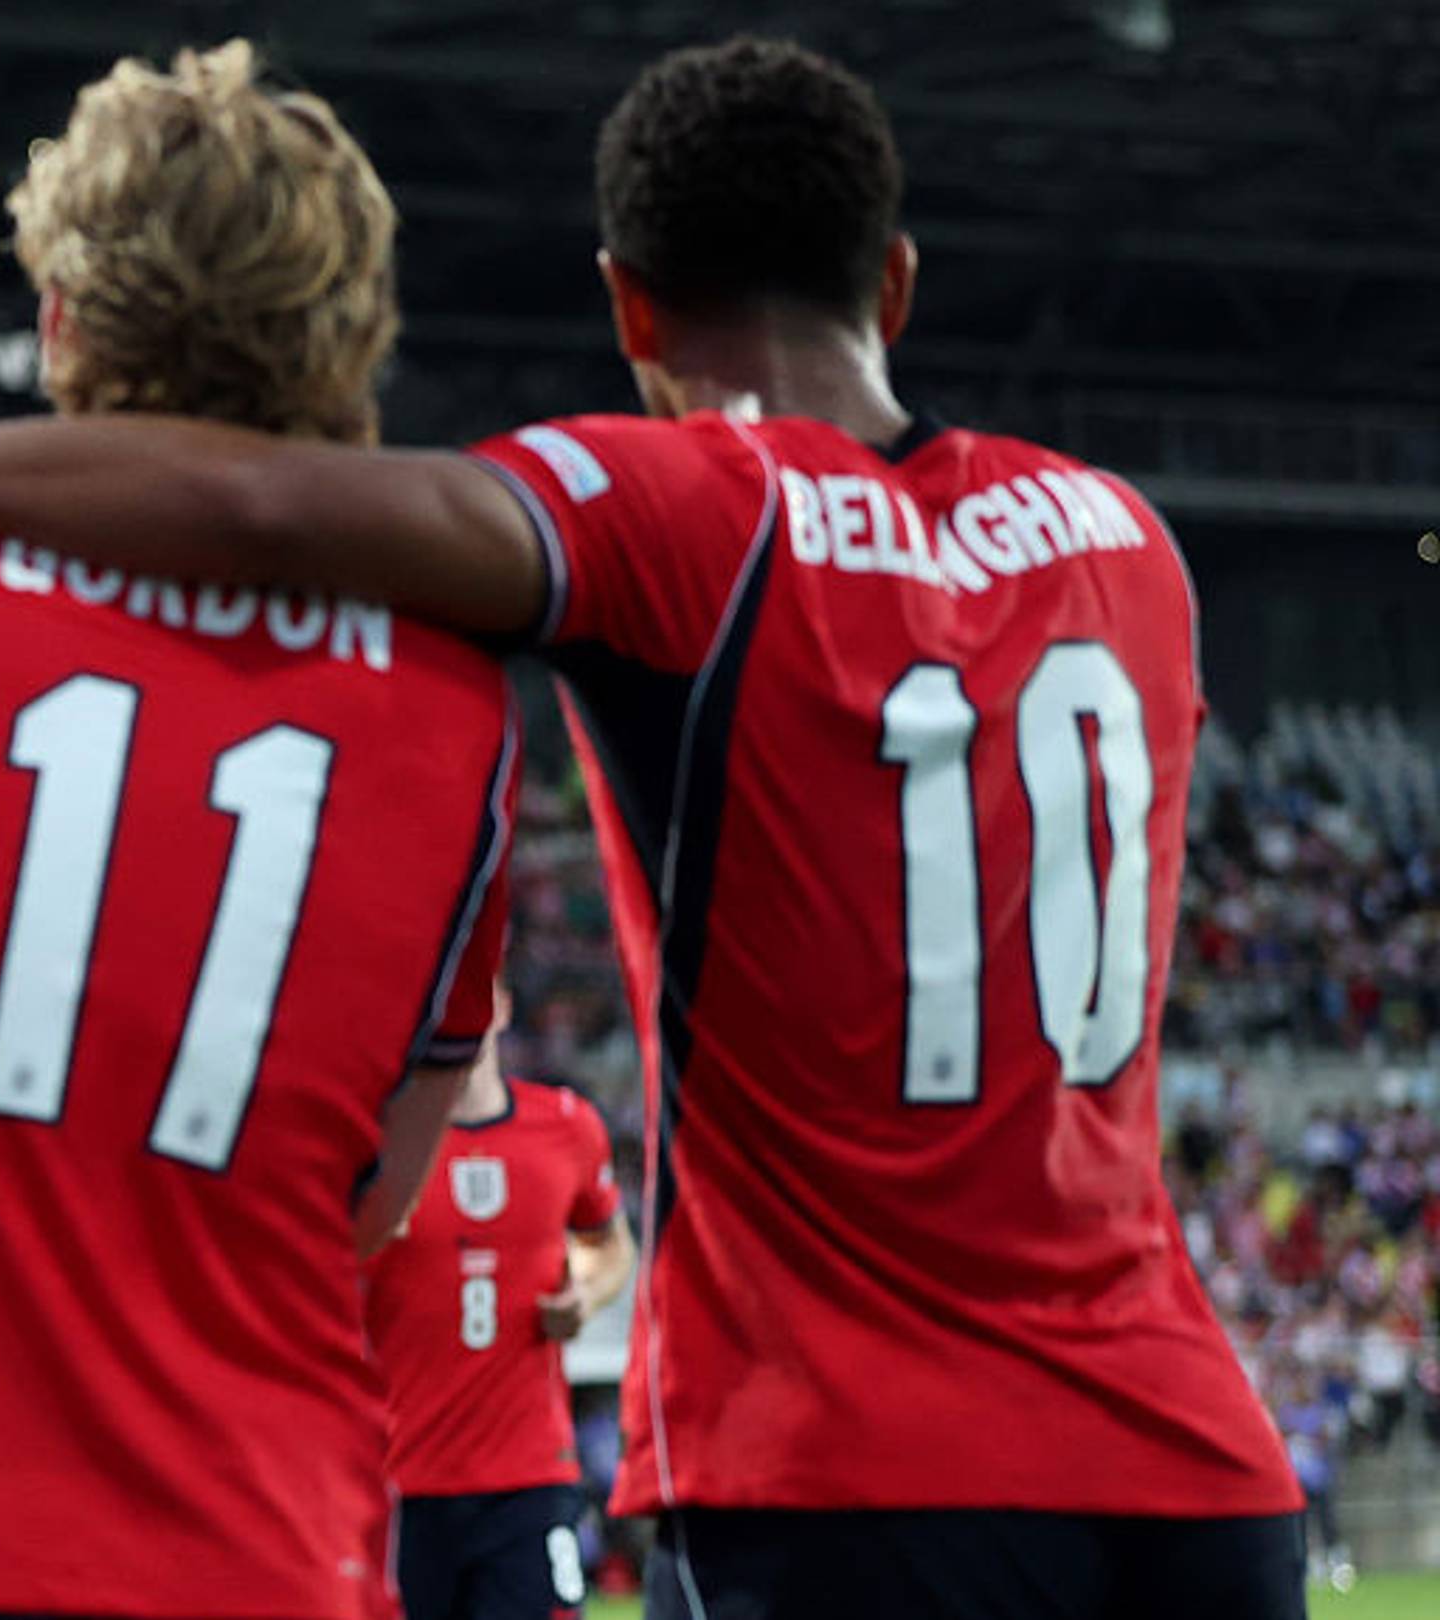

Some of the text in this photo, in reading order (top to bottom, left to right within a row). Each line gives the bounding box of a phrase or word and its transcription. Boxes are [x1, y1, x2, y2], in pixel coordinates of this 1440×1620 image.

[779, 465, 1148, 596] BELLNGHAM
[879, 639, 1154, 1104] 10
[460, 1277, 498, 1351] 8
